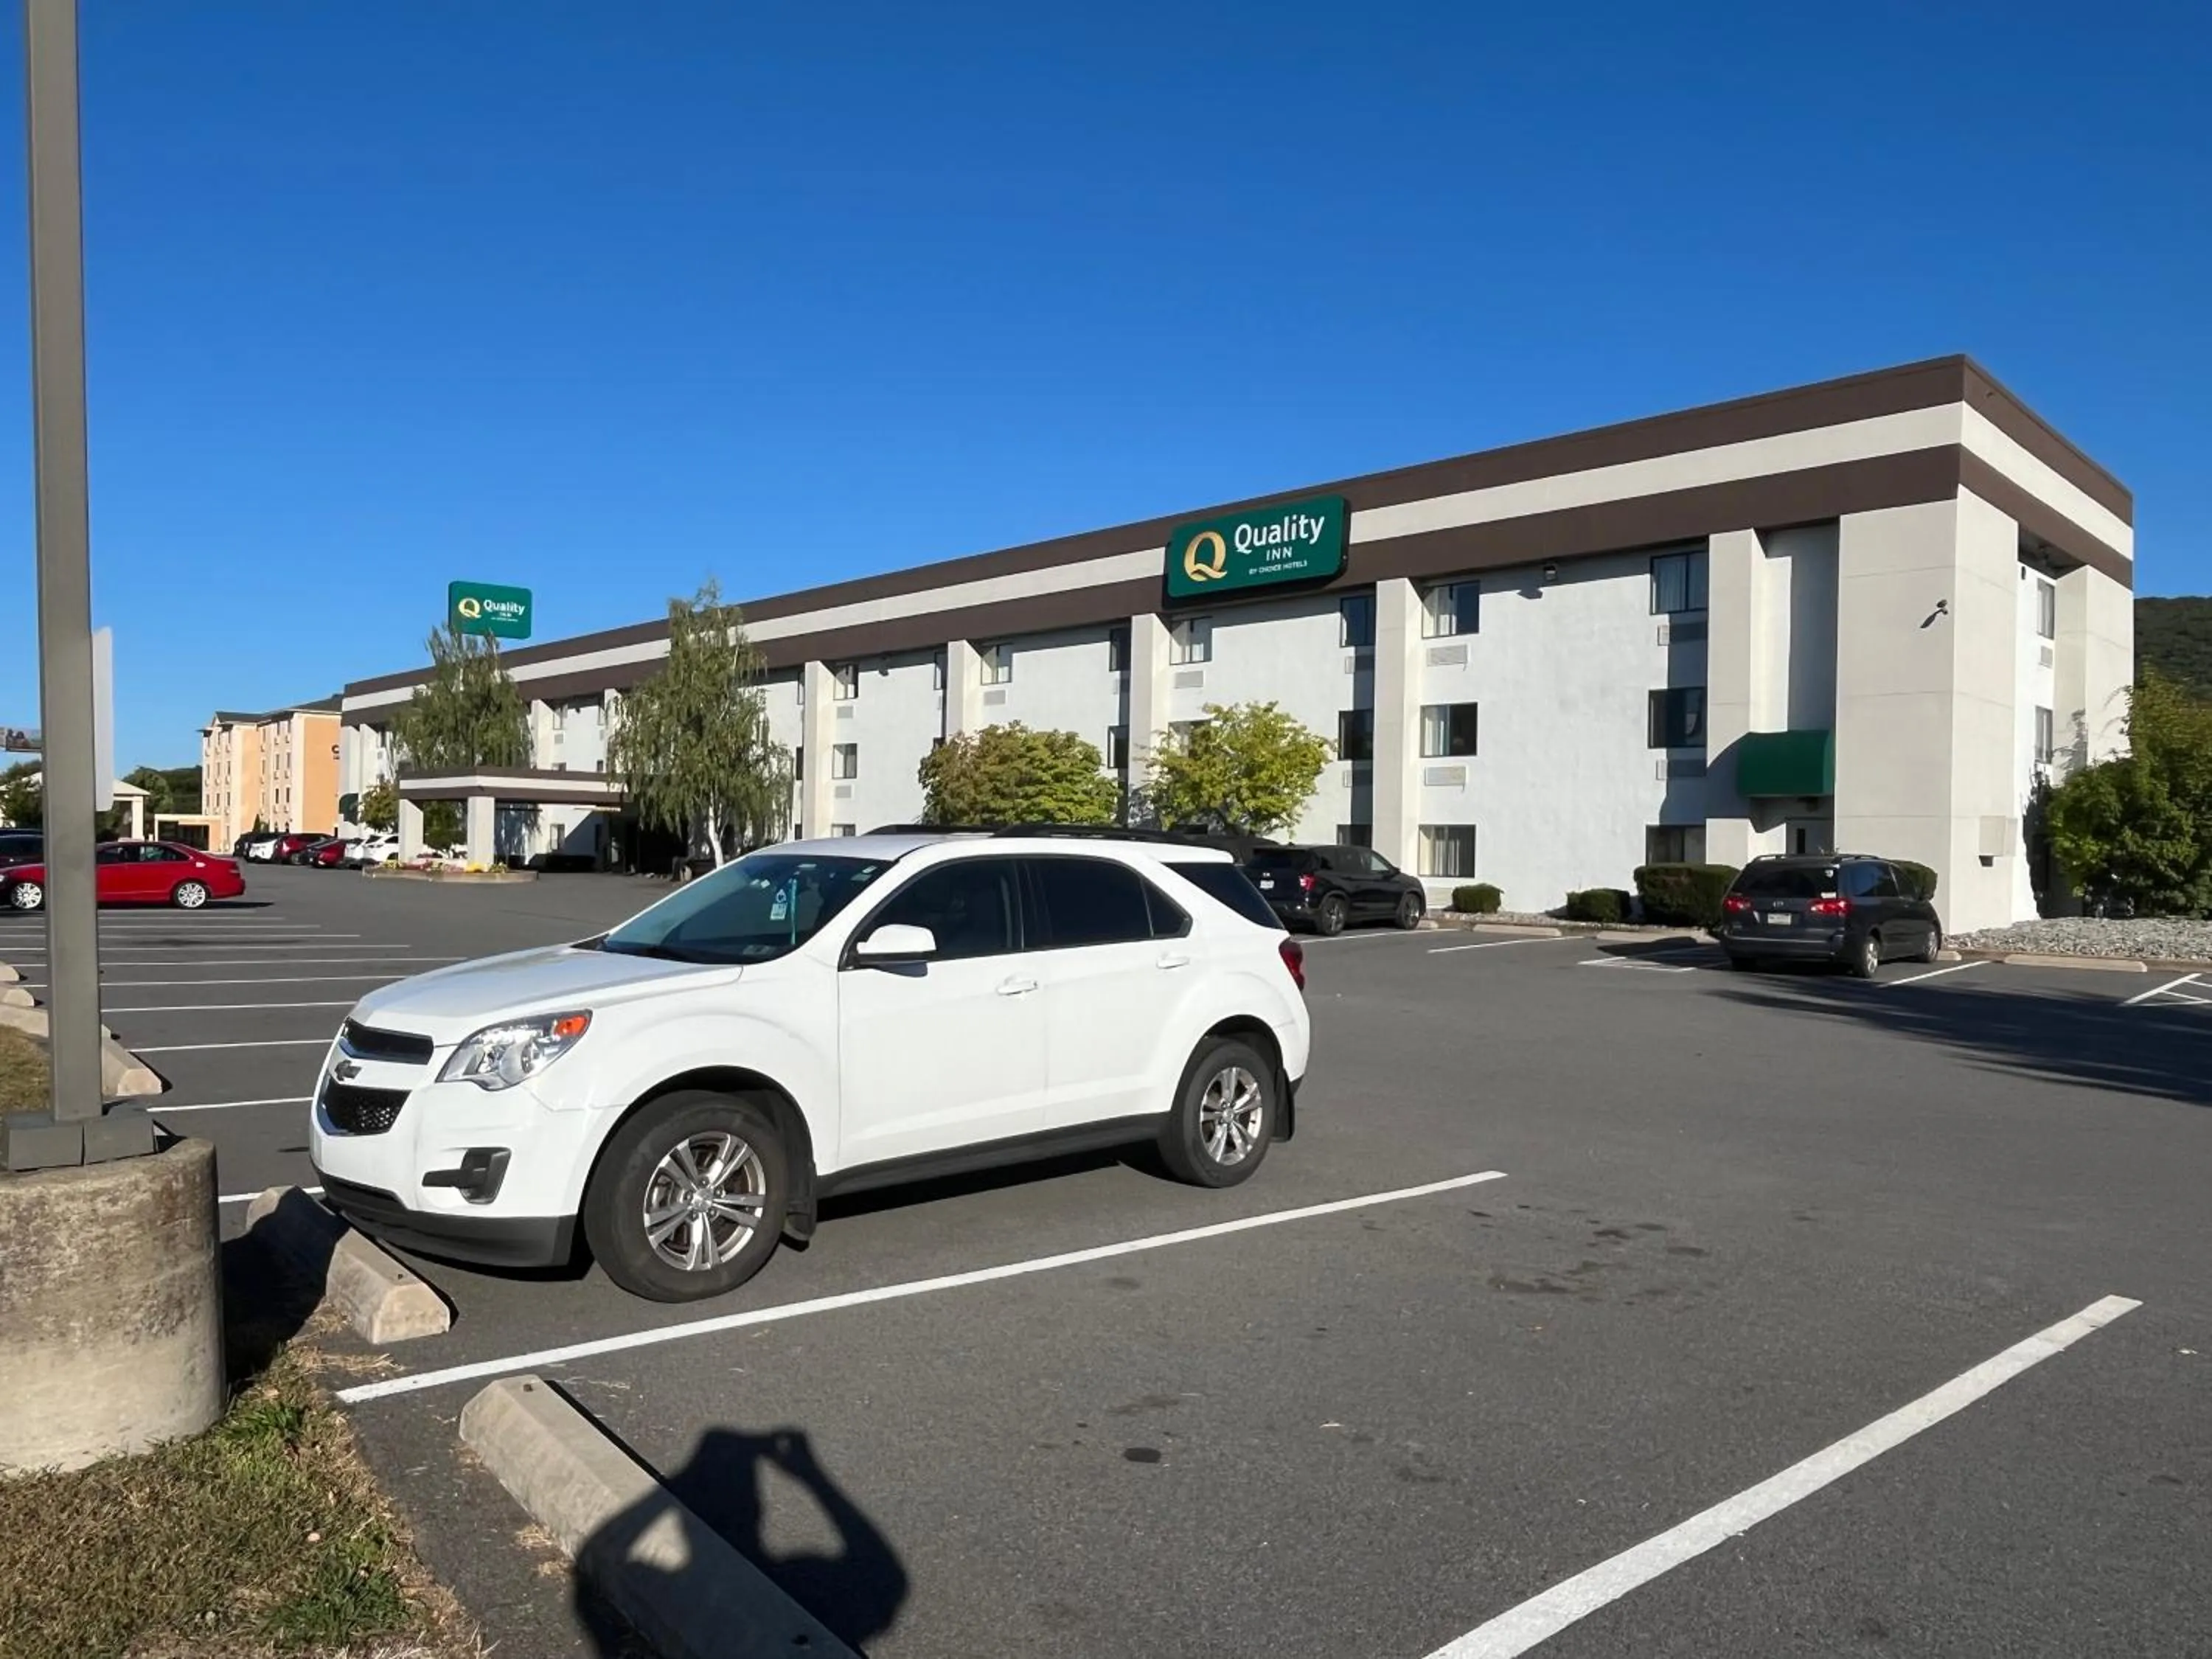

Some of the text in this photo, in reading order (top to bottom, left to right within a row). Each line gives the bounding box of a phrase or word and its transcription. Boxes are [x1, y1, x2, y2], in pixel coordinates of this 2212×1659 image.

[1234, 515, 1325, 554] Quality
[1184, 532, 1227, 582] Q
[1266, 546, 1292, 561] INN
[459, 597, 481, 619] Q
[483, 599, 525, 616] Quality
